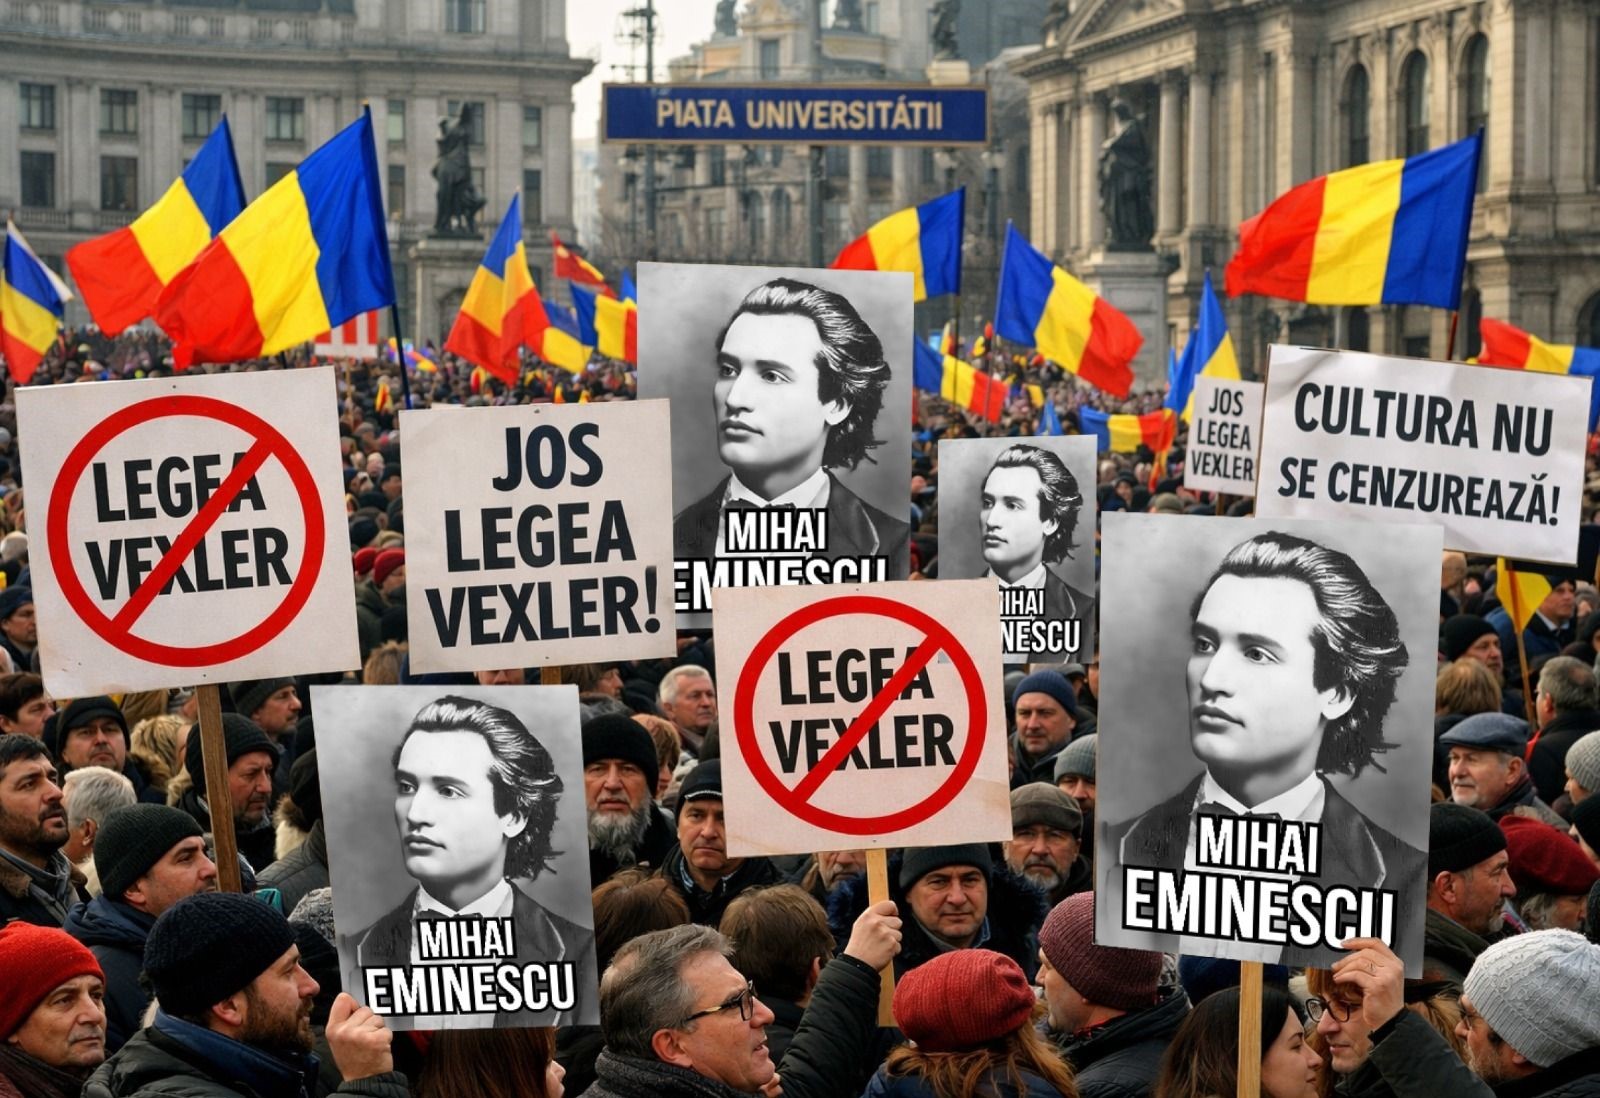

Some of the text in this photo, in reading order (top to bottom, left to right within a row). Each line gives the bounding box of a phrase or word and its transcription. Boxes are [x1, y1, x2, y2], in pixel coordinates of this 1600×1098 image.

[657, 99, 735, 128] PIATA
[1209, 387, 1244, 417] JOS
[1294, 382, 1553, 456] CULTURA NU
[492, 422, 603, 492] JOS
[1197, 417, 1251, 451] LEGEA
[93, 451, 267, 523] LEGEA
[1191, 449, 1255, 482] VEXLER
[1277, 457, 1560, 526] SE CENZUREAZĂ!
[445, 500, 637, 573] LEGEA
[728, 512, 826, 550] MIHAI
[84, 527, 293, 600] VEXLER
[425, 565, 661, 648] VEXLER!
[999, 590, 1045, 615] IHAI
[1000, 620, 1080, 653] NESCU
[778, 646, 935, 705] LEGEA
[768, 713, 957, 774] VEXLER
[1199, 816, 1318, 874] MIHAI
[1125, 868, 1394, 949] EMINESCU
[419, 919, 514, 958] MIHAI
[365, 963, 576, 1014] EMINESCU
